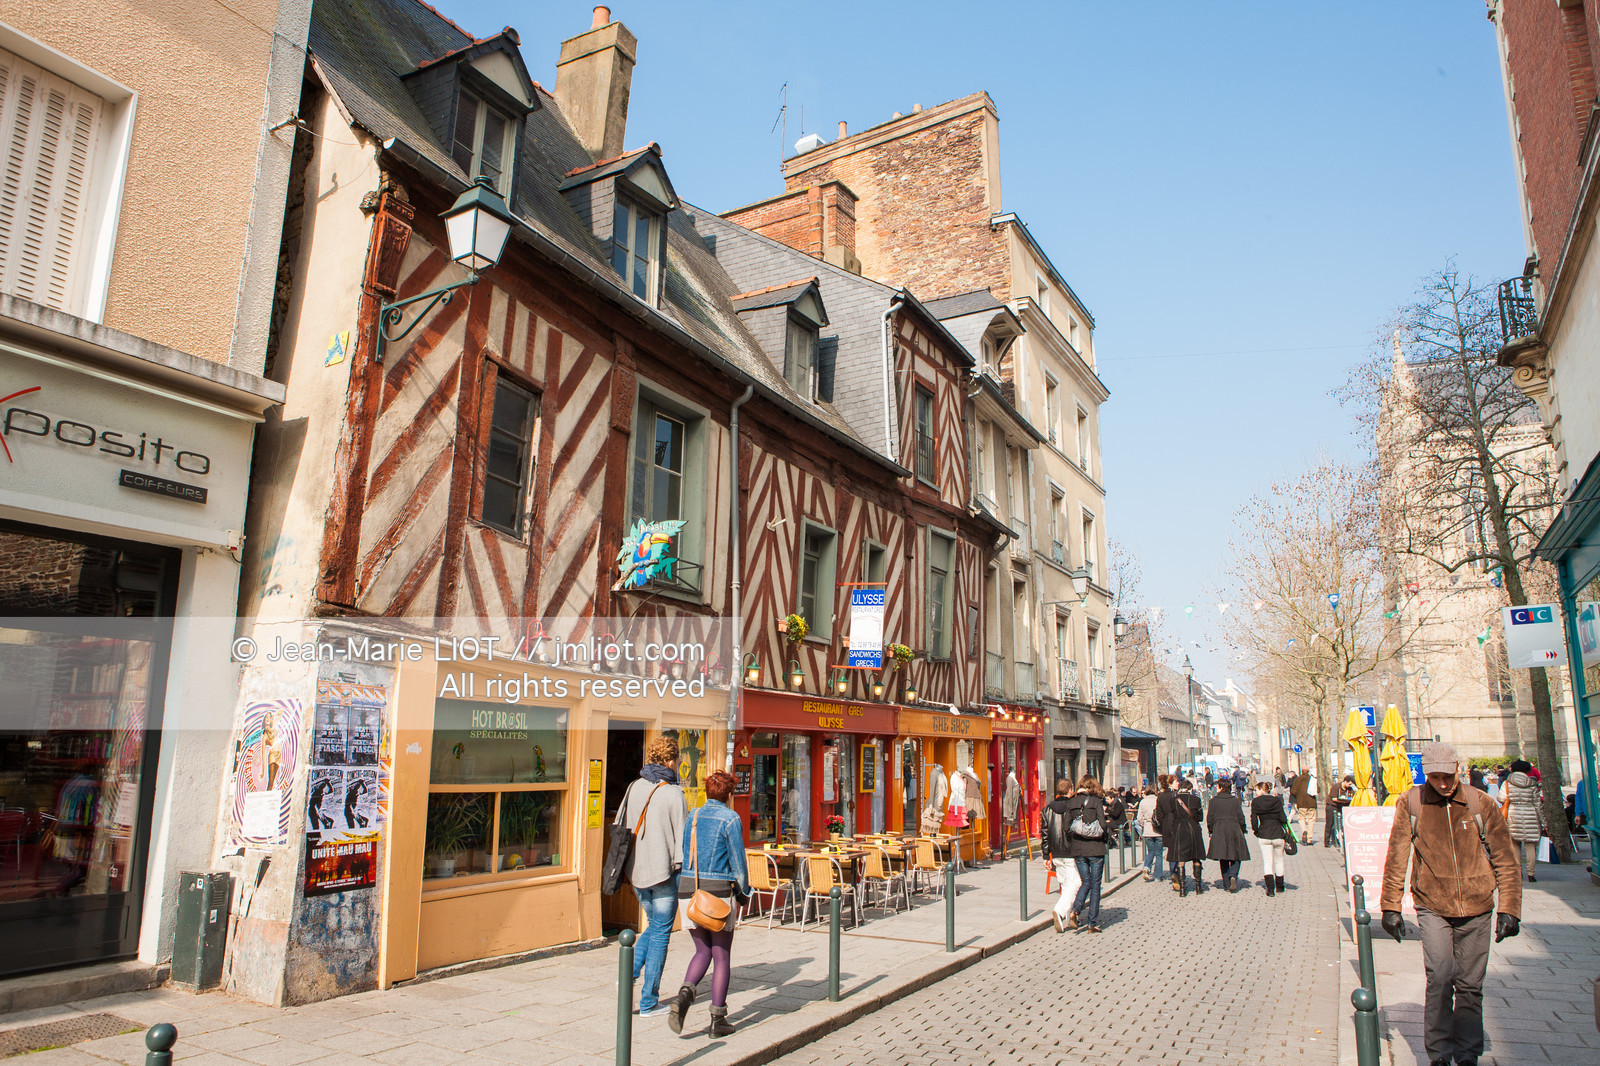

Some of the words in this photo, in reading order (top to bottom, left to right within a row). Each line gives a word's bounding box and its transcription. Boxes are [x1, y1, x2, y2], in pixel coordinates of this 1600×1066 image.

[123, 474, 204, 500] COIFFEURS
[852, 593, 885, 605] ULYSSE
[1515, 609, 1548, 622] CIC
[803, 701, 844, 715] RESTAURANT
[848, 706, 864, 717] GREC
[471, 709, 494, 729] HOT
[495, 711, 528, 730] BR@SIL
[818, 716, 845, 729] ULYSSE
[932, 716, 949, 732] THE
[950, 718, 970, 734] SHOP
[469, 729, 528, 740] SPÉCIALITÉS
[311, 845, 335, 859] UNITÉ
[336, 843, 355, 856] MAU
[355, 841, 373, 854] MAU
